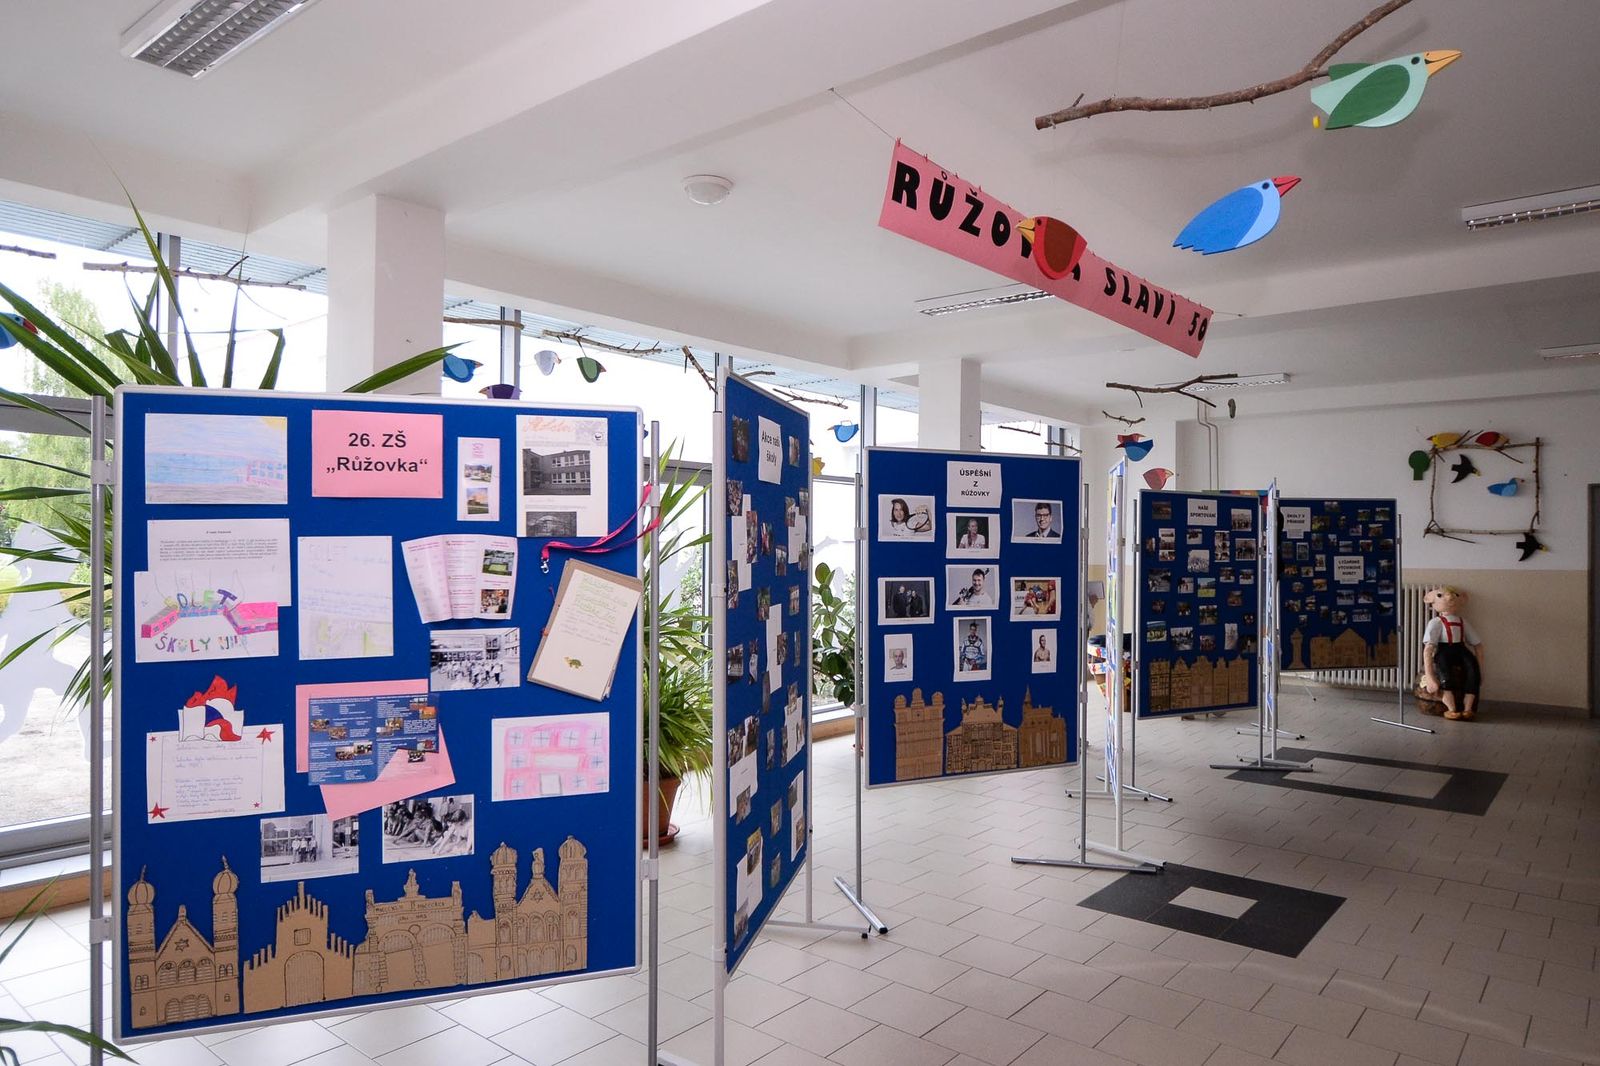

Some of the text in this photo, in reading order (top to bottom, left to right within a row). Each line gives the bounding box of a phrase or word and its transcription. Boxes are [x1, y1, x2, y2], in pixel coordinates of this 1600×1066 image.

[1187, 311, 1208, 342] 50
[348, 430, 407, 448] 26. ZŠ
[761, 429, 773, 445] Akce
[326, 455, 428, 474] „Růžovka“
[959, 467, 992, 478] ÚSPĚŠNÍ
[973, 480, 979, 488] Z
[960, 488, 991, 497] RŮŽOVKY
